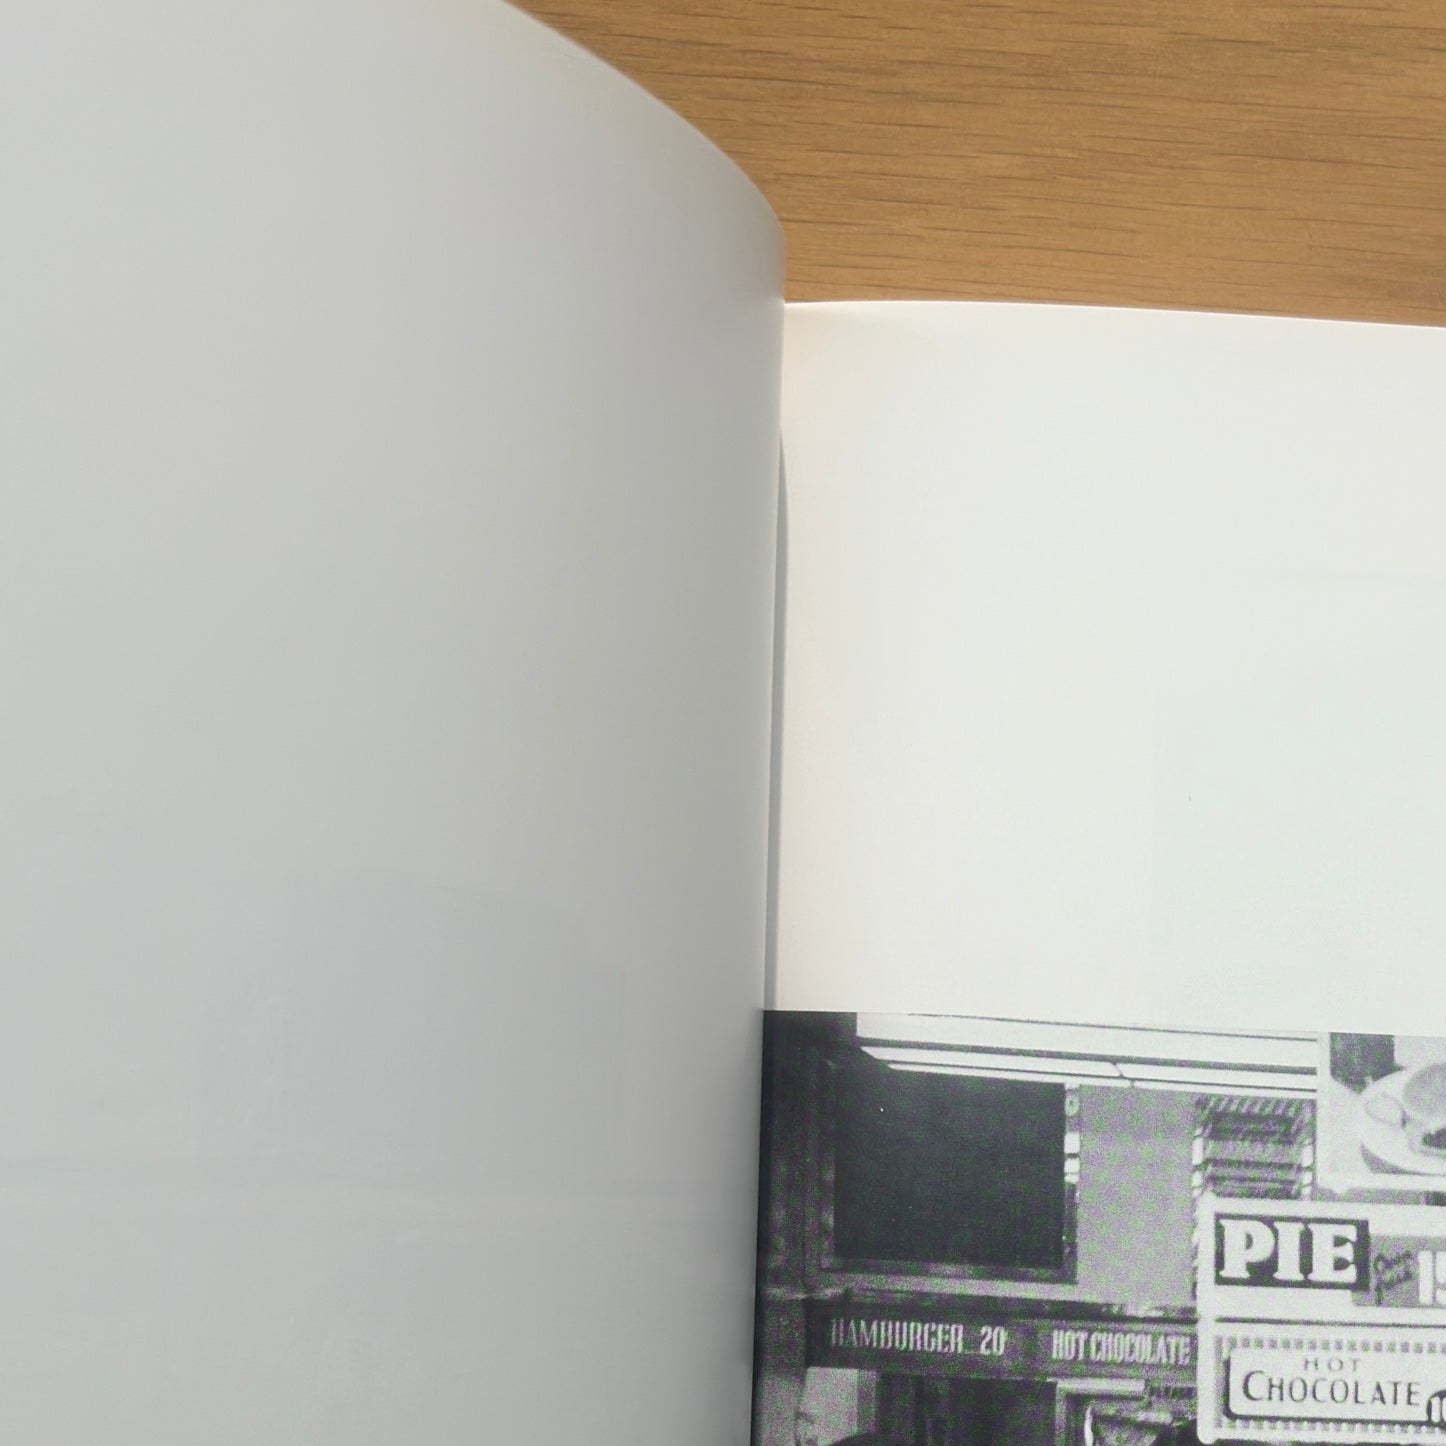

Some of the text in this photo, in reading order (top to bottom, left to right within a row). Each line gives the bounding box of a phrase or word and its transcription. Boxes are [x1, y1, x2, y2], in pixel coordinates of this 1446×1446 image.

[1219, 1218, 1357, 1283] PIE
[831, 1316, 964, 1354] HAMBURGER
[1052, 1329, 1192, 1366] HOT CHOCOLATE
[1303, 1357, 1361, 1372] HOT
[1242, 1369, 1421, 1407] CHOCOLATE
